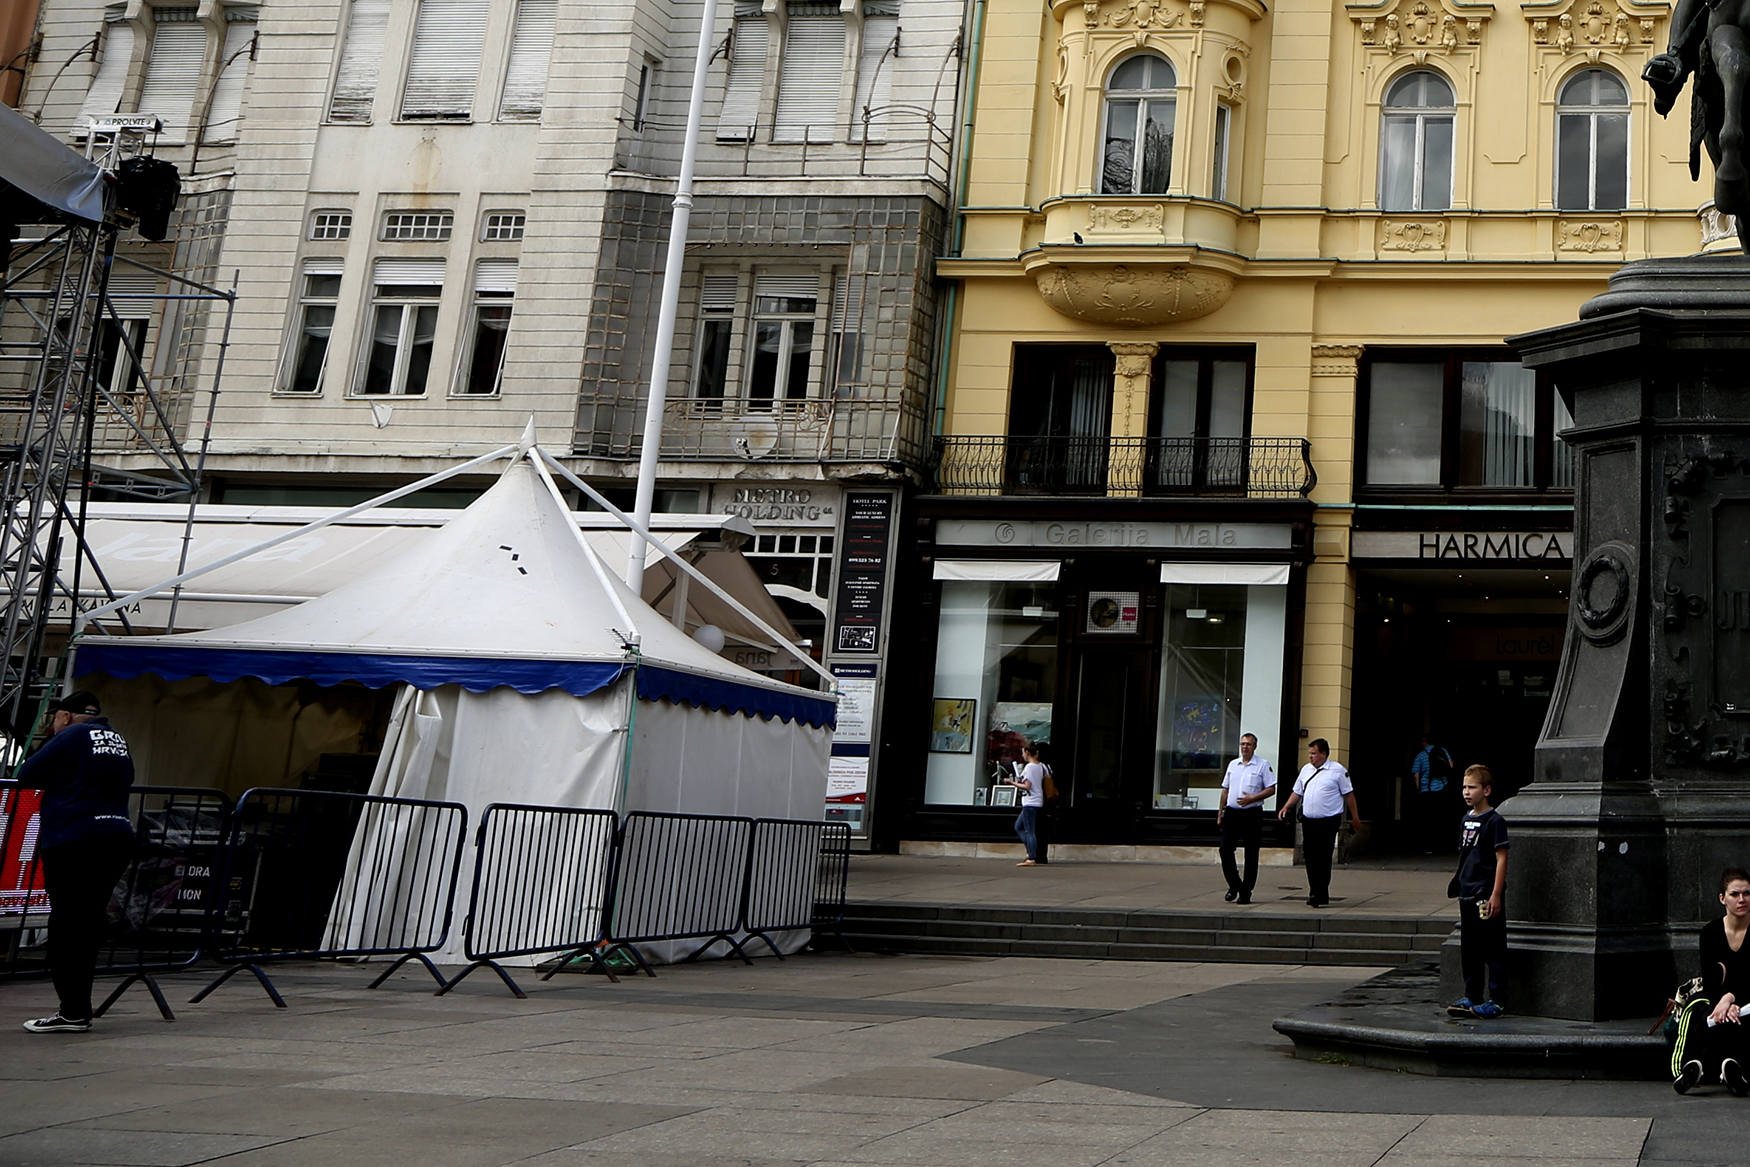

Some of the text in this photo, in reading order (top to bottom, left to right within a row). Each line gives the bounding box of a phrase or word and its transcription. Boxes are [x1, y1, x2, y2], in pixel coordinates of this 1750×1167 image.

[732, 488, 812, 504] METRO
[724, 504, 821, 521] HOLDING
[1045, 523, 1238, 547] Galerija Mala
[1419, 532, 1566, 559] HARMICA
[771, 564, 779, 575] 5
